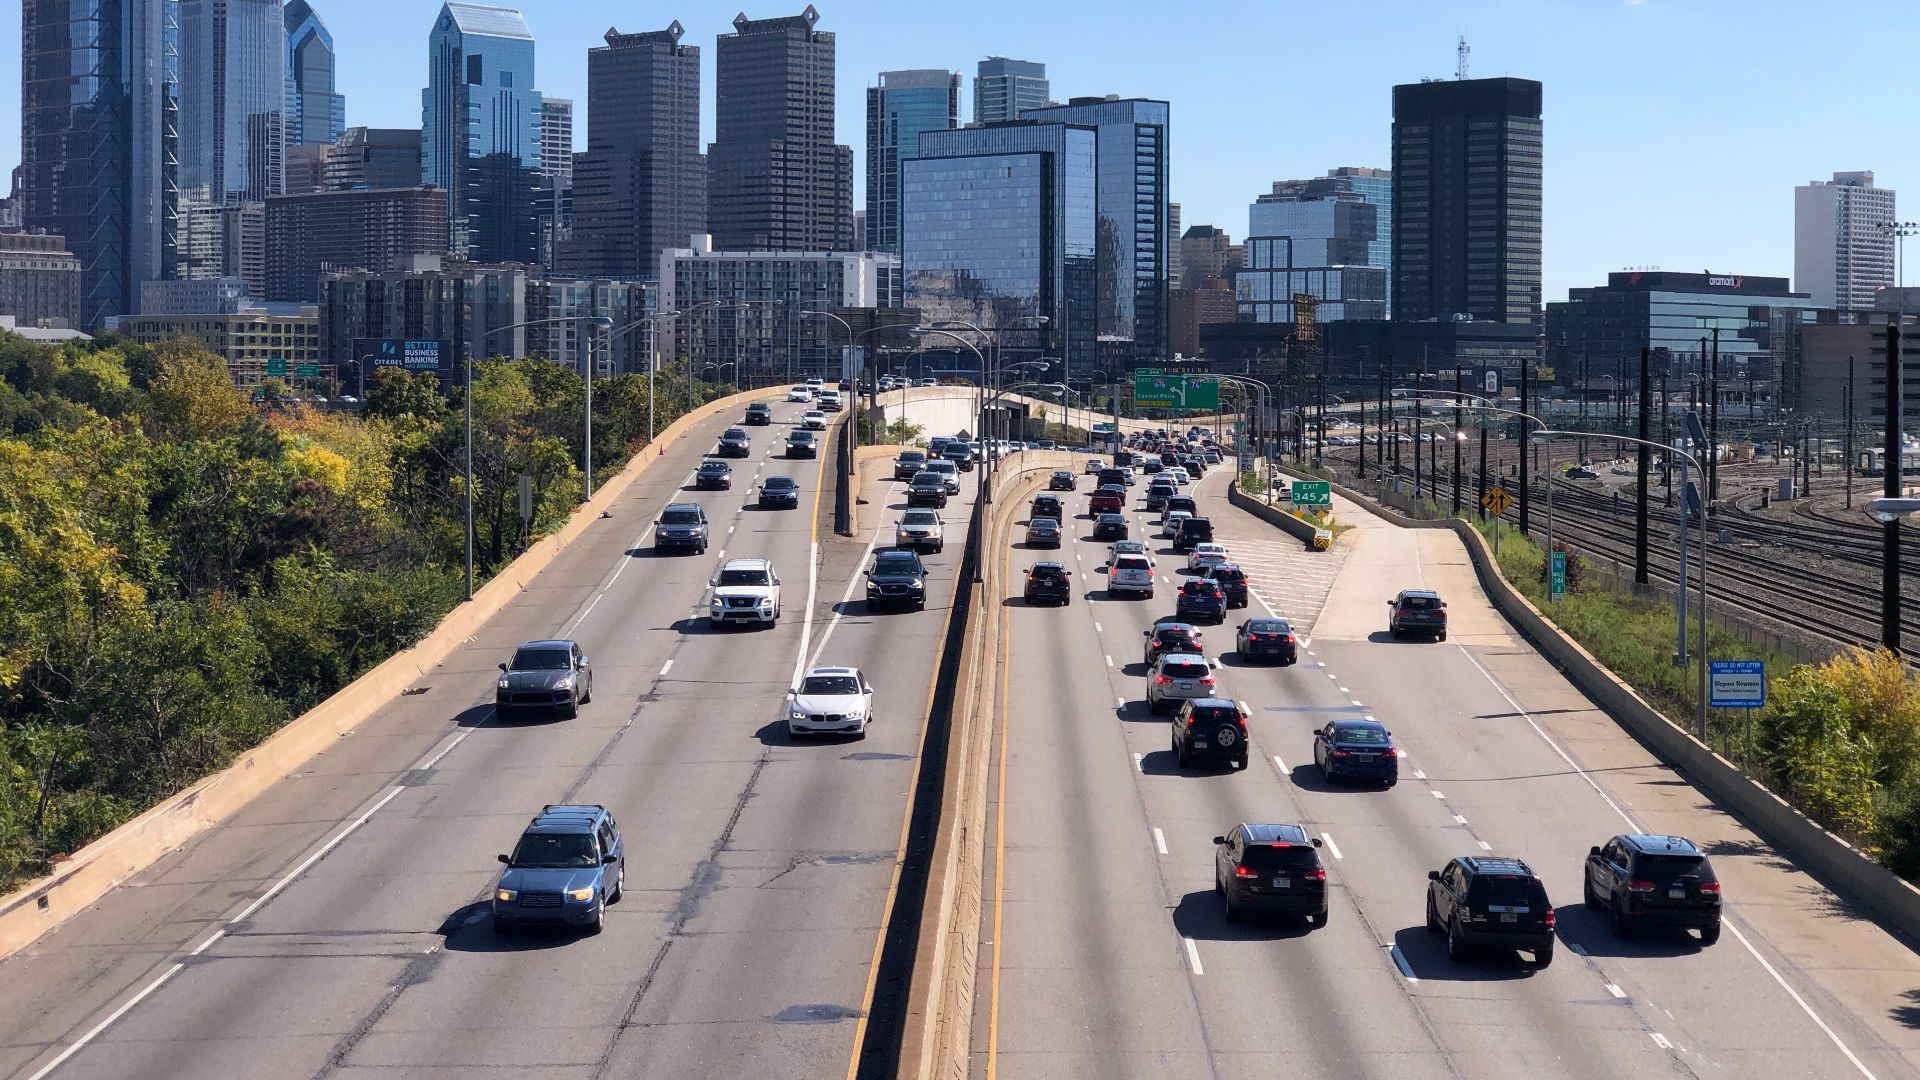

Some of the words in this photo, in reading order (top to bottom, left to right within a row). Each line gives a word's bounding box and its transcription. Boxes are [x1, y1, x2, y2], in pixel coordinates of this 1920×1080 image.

[1709, 277, 1735, 286] aramark
[405, 341, 439, 349] BETTER
[405, 356, 439, 364] BANKING
[1293, 492, 1316, 501] 345
